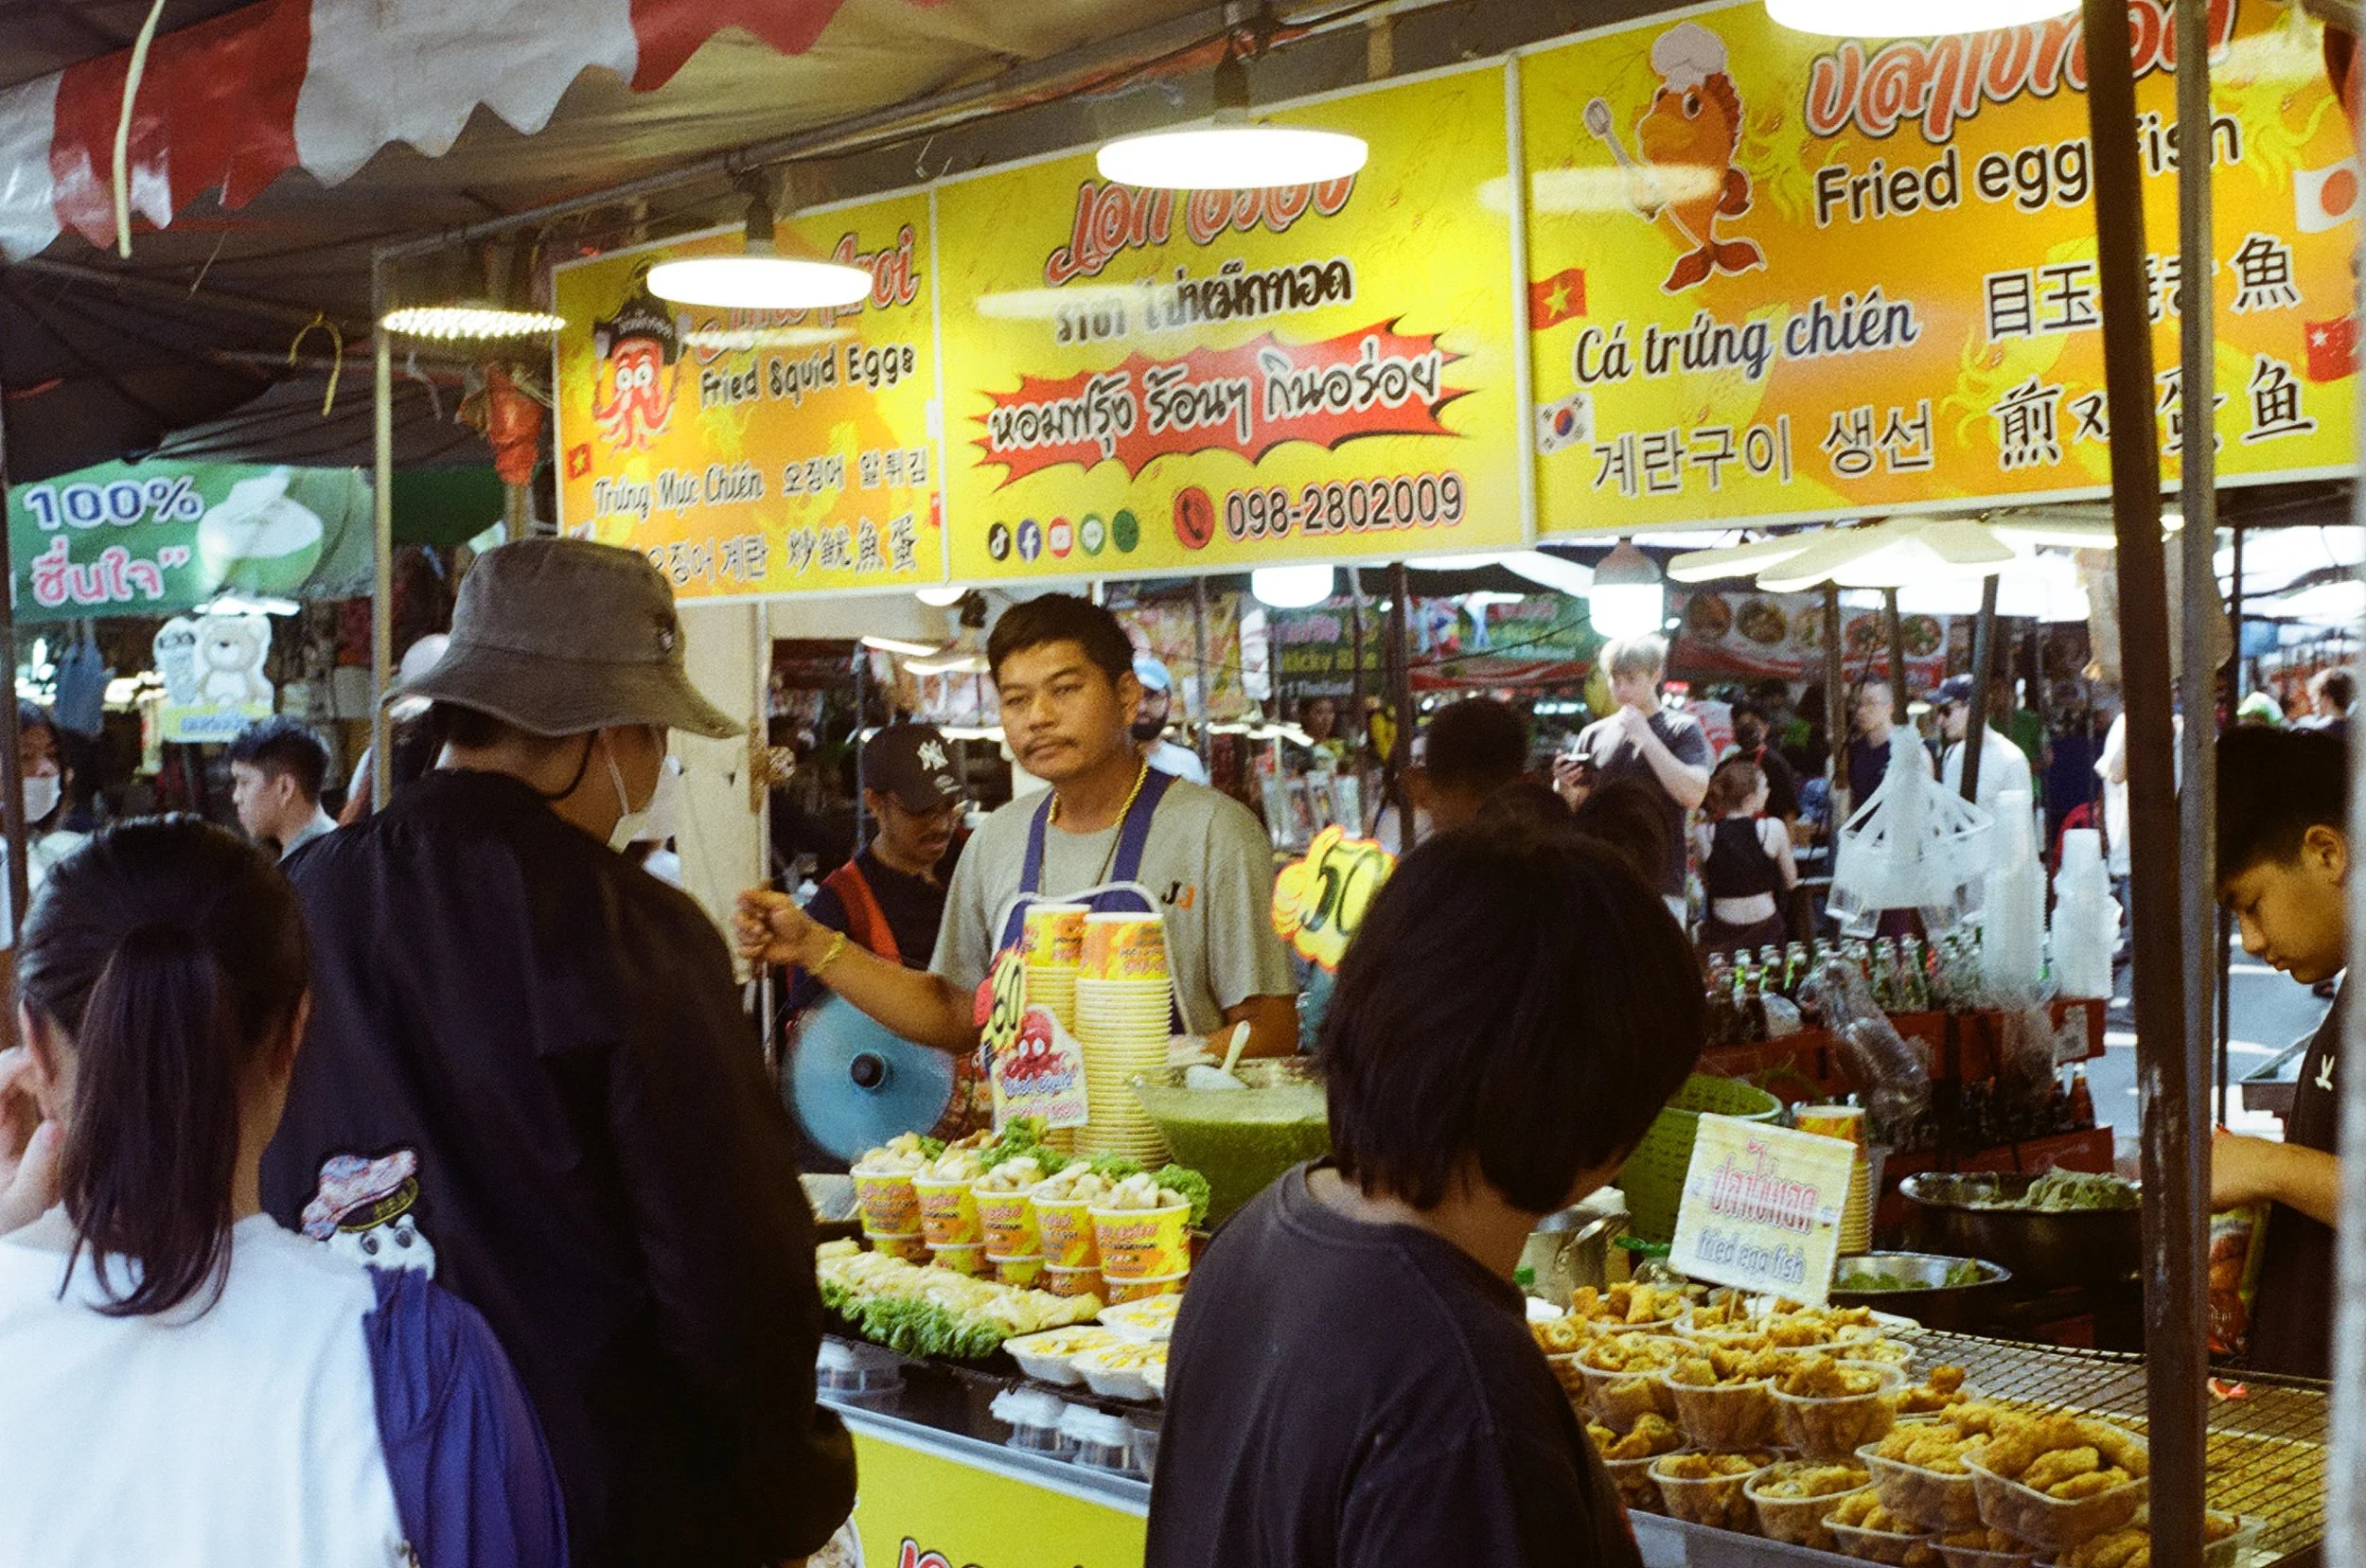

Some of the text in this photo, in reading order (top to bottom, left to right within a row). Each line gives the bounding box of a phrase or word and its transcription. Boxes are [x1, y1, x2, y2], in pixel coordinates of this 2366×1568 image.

[1814, 110, 2240, 225] Fried egg ish
[1988, 237, 2299, 342] 目玉魚
[700, 344, 916, 408] Fried Squid Eggs
[1577, 323, 1633, 383] Cá
[1992, 361, 2316, 467] 煎鱼
[782, 454, 845, 497] 오징어
[1592, 401, 1934, 498] 계란구이 생선
[27, 478, 202, 528] 100%
[1226, 473, 1463, 537] 098-2802009
